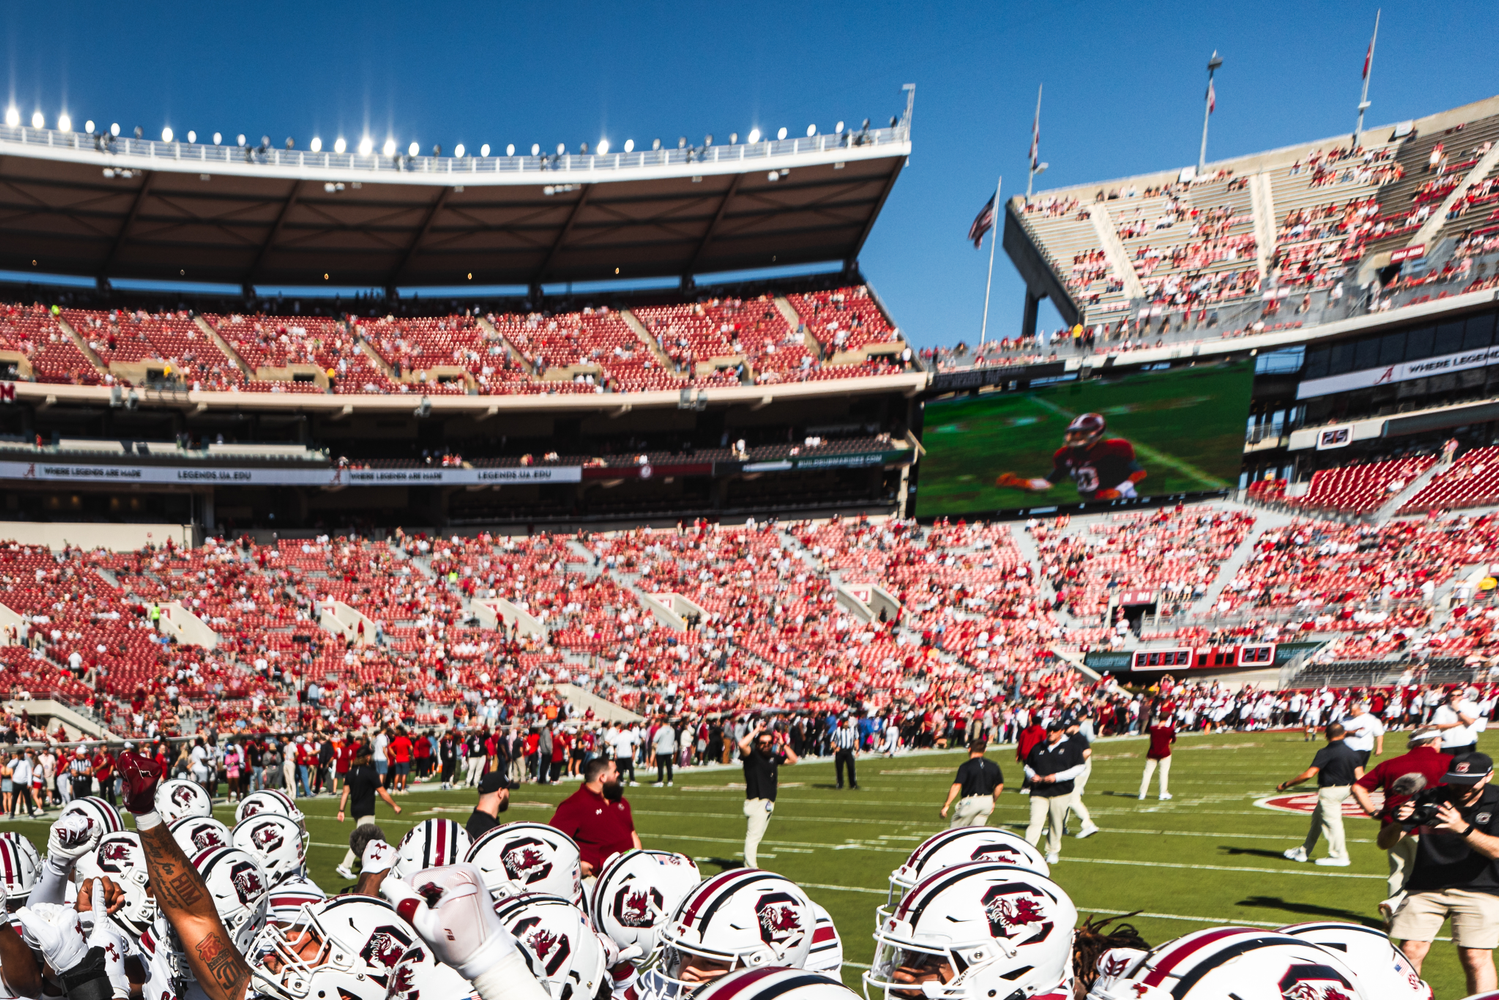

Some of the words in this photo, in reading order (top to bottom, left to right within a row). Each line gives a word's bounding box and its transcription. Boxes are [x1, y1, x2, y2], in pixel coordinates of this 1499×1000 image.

[1408, 359, 1451, 374] WHERE
[44, 466, 70, 477] WHERE
[71, 467, 104, 477] LEGENDS
[105, 469, 120, 478] ARE
[120, 470, 142, 478] MADE
[177, 470, 252, 481] LEGENDS.UA.EDU
[477, 469, 552, 481] LEGENDS.UA.EDU
[1243, 647, 1269, 663] 25
